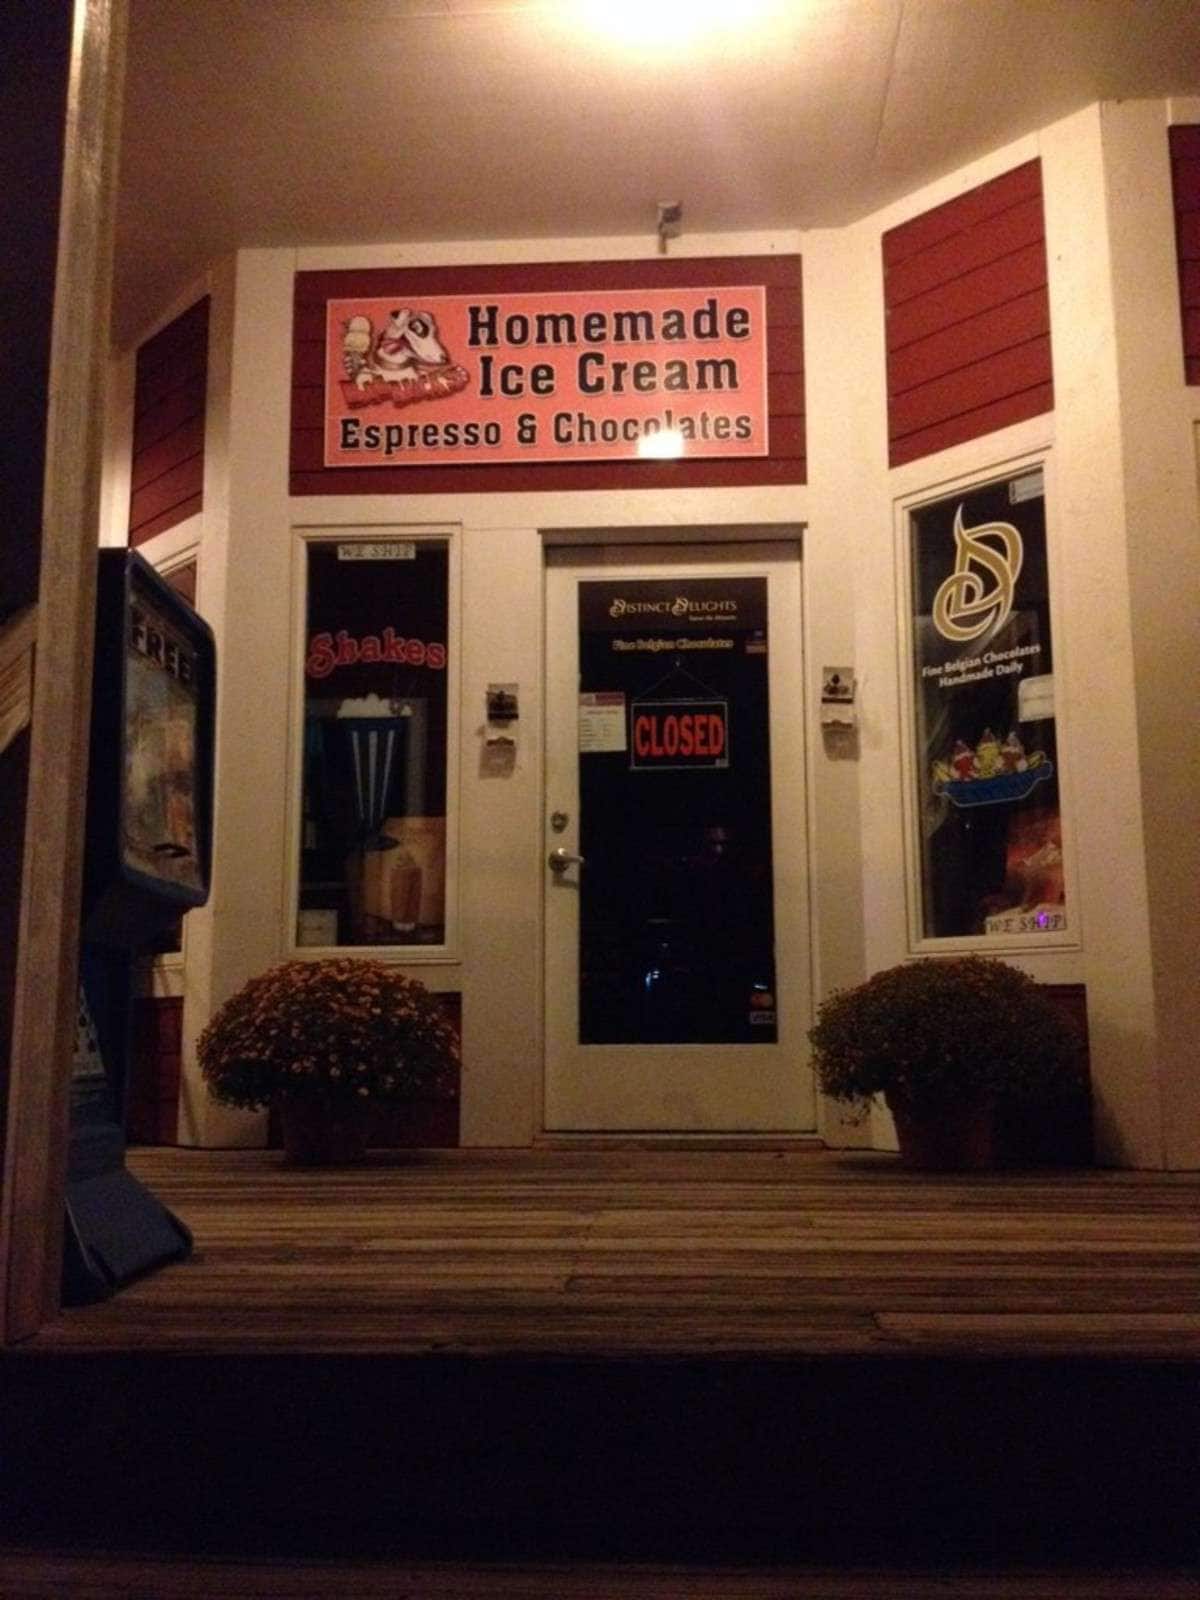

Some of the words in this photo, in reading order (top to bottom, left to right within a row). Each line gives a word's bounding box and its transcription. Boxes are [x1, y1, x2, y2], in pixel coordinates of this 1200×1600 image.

[467, 298, 752, 347] Homemade
[478, 354, 556, 397] Ice
[577, 351, 739, 395] Cream
[340, 416, 501, 454] Espresso
[516, 413, 537, 445] &
[305, 627, 446, 678] Shakes
[922, 664, 943, 678] Fine
[944, 656, 982, 673] Belgian
[983, 643, 1041, 664] Chocolates
[938, 668, 994, 687] Handmade
[996, 661, 1023, 677] Daily
[635, 714, 724, 757] CLOSED
